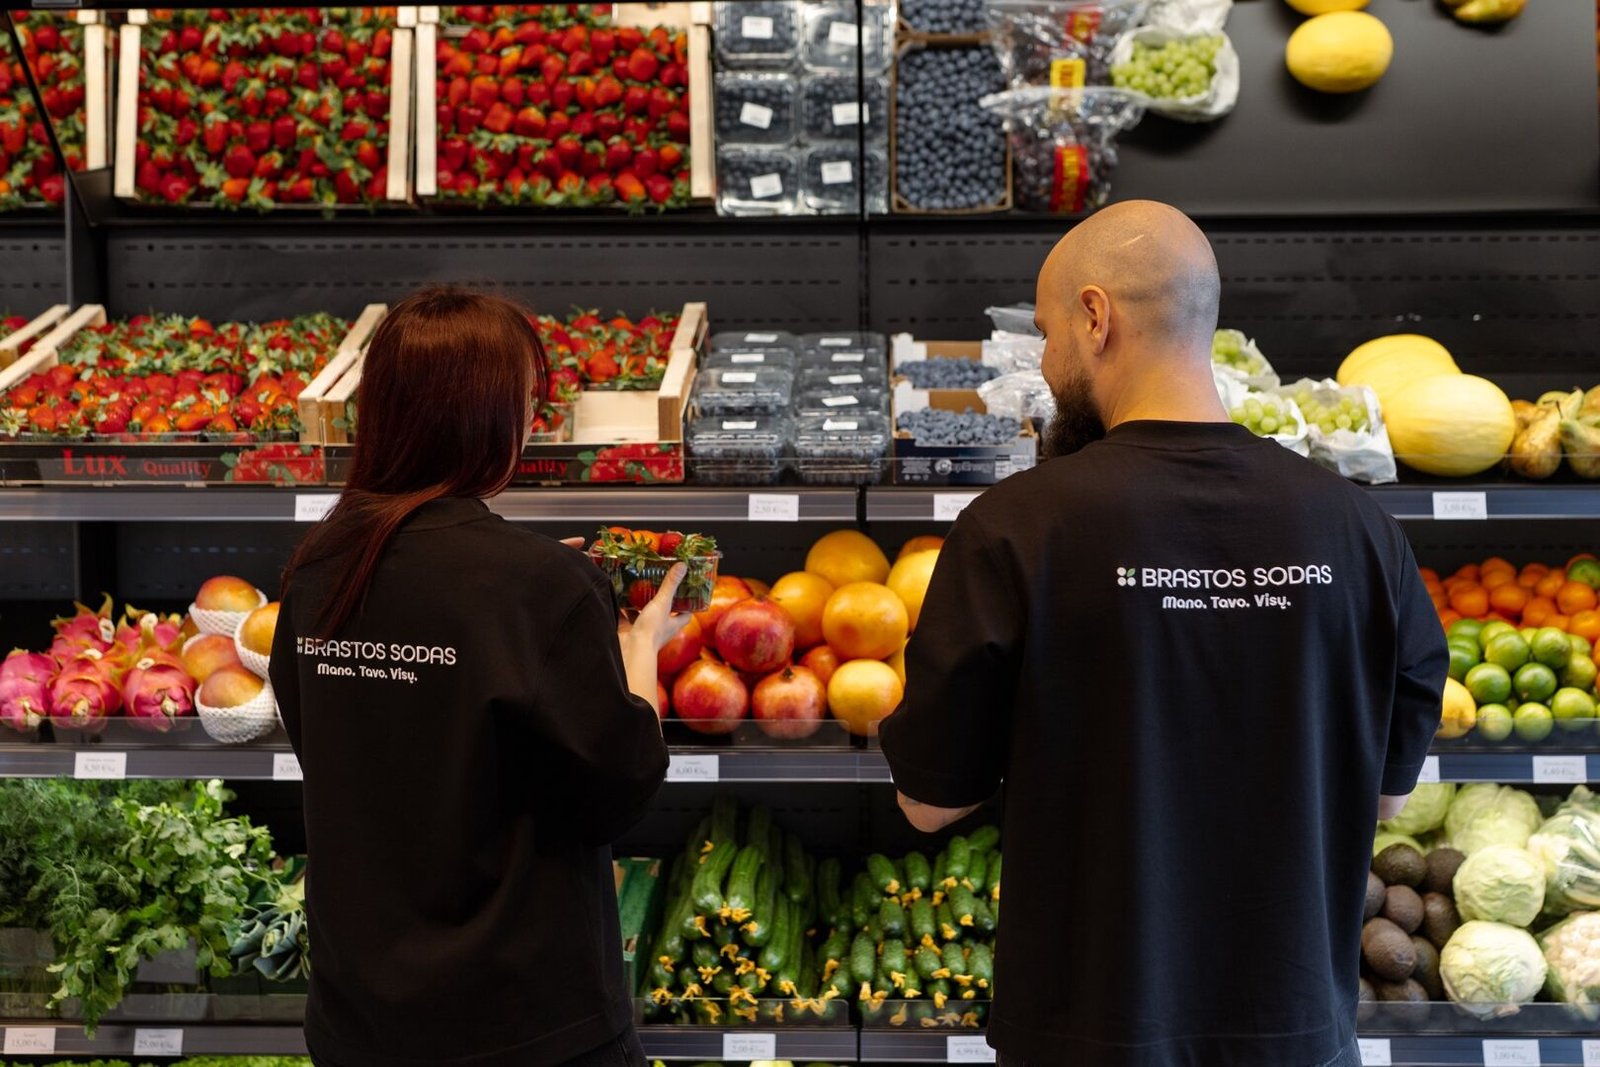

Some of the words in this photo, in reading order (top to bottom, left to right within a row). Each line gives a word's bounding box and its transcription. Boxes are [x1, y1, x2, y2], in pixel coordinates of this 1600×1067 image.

[62, 448, 127, 475] Lux
[143, 459, 211, 477] Quality
[1141, 567, 1247, 589] BRASTOS
[1253, 564, 1333, 587] SODAS
[1162, 595, 1208, 609] Mano.
[1210, 595, 1251, 609] Tavo.
[1254, 592, 1292, 610] Visų.
[304, 637, 386, 660] BRASTOS
[390, 644, 457, 665] SODAS
[317, 662, 356, 677] Mano.
[359, 665, 389, 679] Tavo.
[390, 667, 418, 684] Visų.
